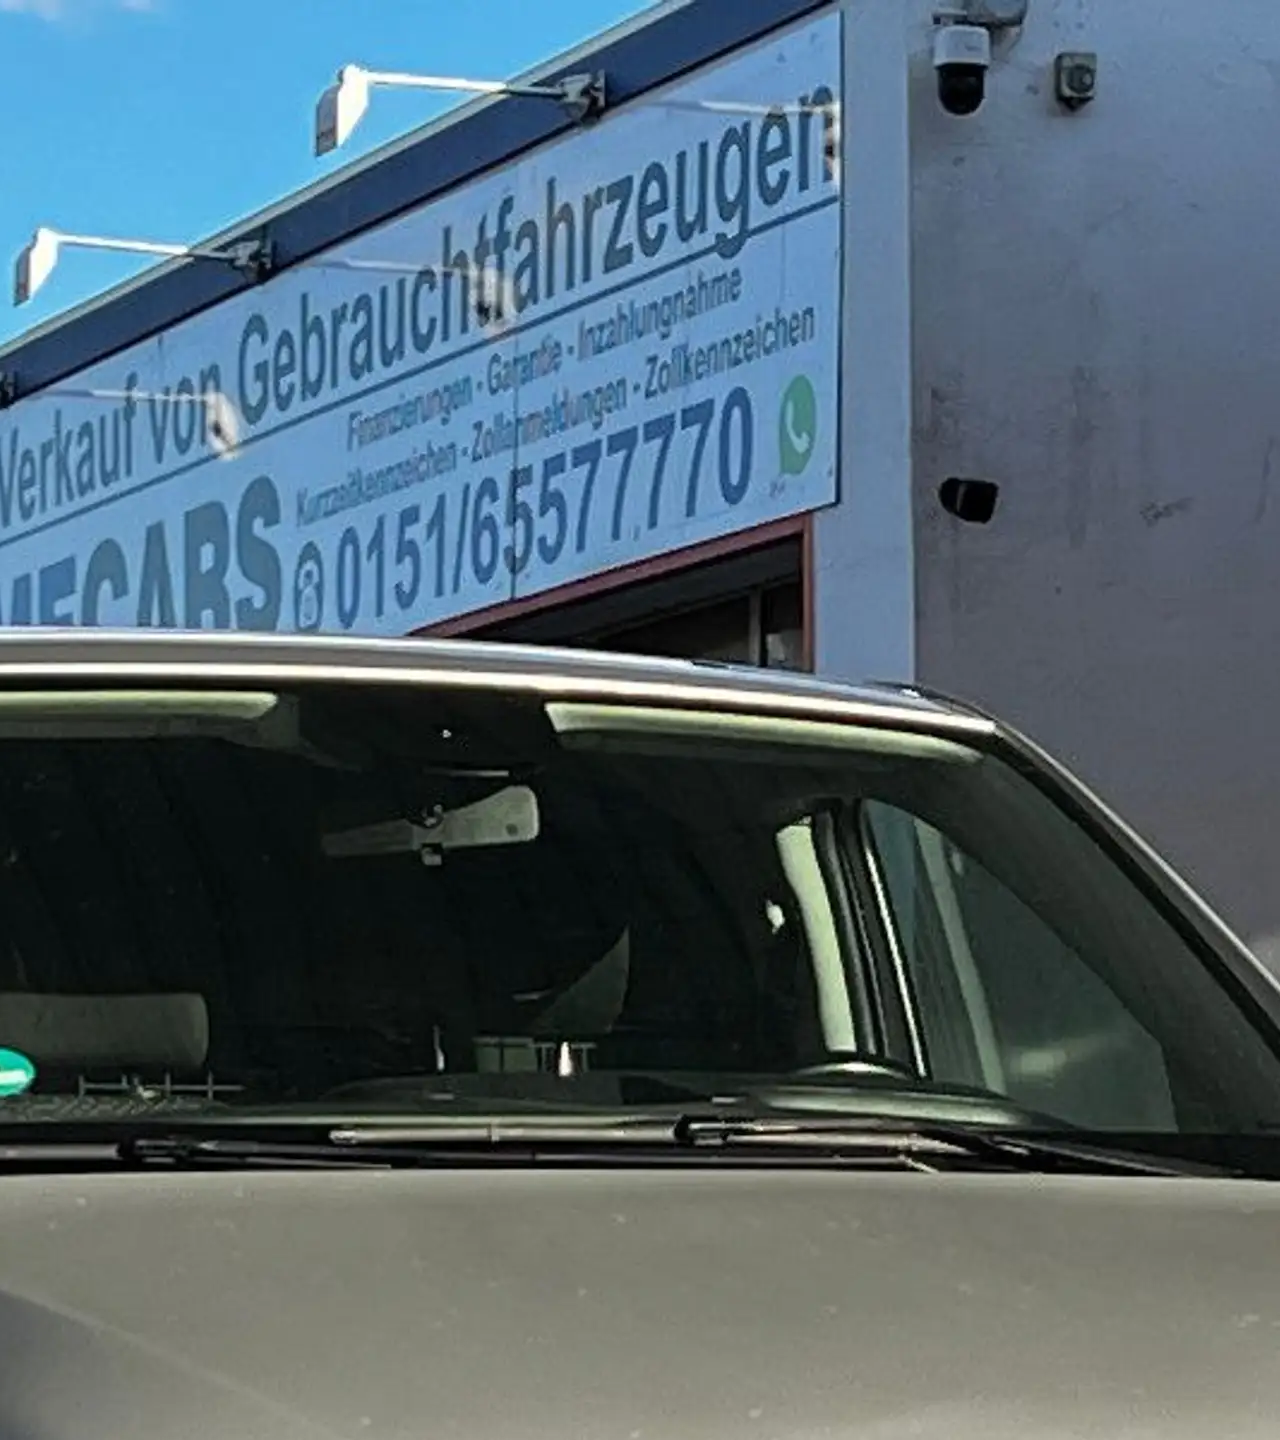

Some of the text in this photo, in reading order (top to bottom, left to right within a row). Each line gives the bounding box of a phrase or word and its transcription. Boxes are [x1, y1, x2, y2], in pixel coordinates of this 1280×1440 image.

[149, 361, 221, 465] von
[238, 85, 834, 426] Gebrauchtfahrzeugen
[487, 333, 562, 396] Garantie
[577, 266, 743, 362] Inzahlungnahme
[645, 304, 815, 400] Zollkennzeichen
[337, 385, 754, 630] 0151/65577770
